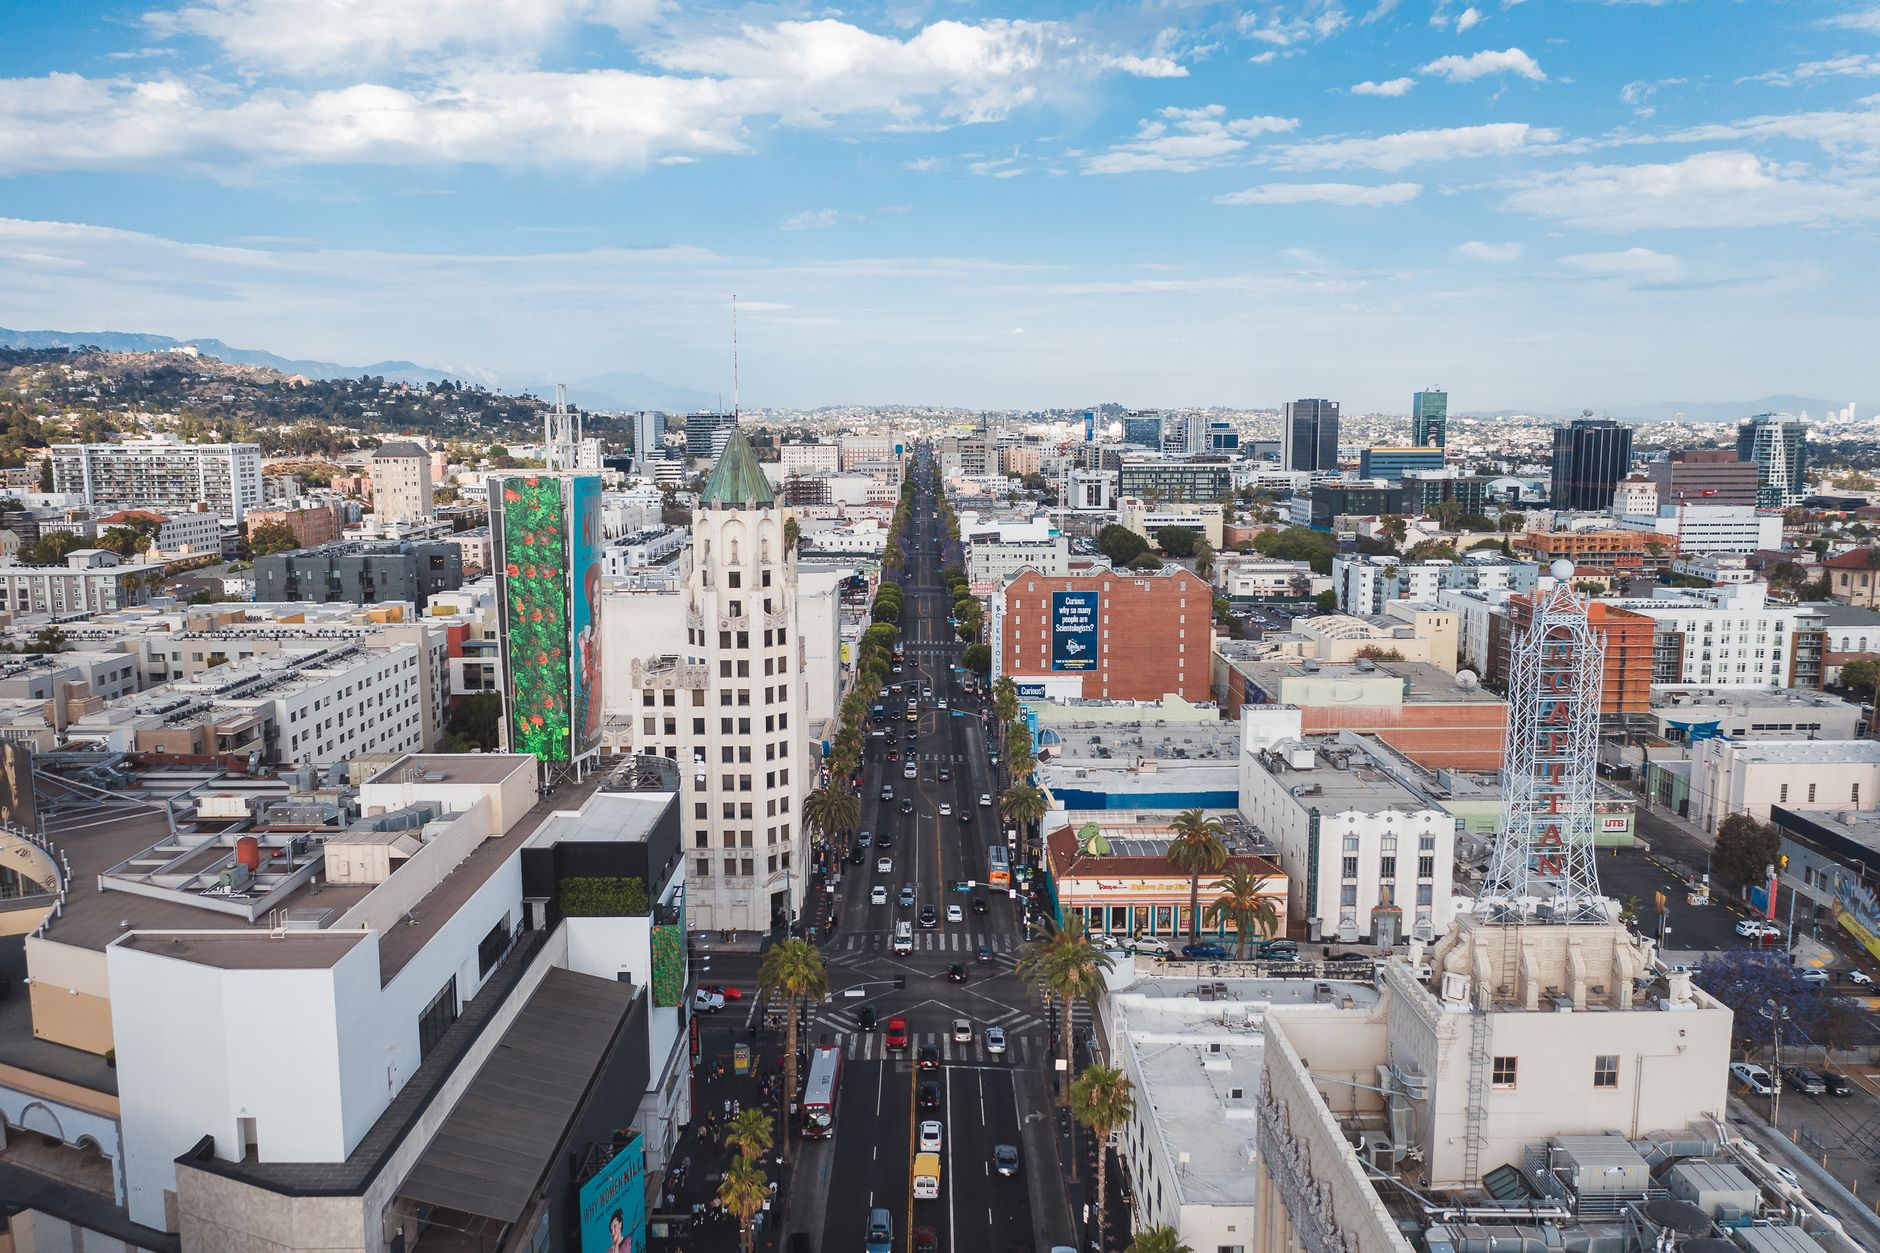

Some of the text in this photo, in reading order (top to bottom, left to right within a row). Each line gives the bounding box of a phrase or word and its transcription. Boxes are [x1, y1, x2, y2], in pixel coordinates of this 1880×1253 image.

[1065, 597, 1085, 605] Curious
[1058, 606, 1069, 615] why
[1077, 607, 1091, 615] many
[1061, 615, 1078, 624] people
[1055, 623, 1094, 633] Scientologists?
[1021, 686, 1046, 696] Curious?
[1537, 673, 1573, 876] CAPITAN
[584, 1199, 600, 1224] WHY
[600, 1176, 622, 1207] WOMEN
[623, 1157, 642, 1185] KILL
